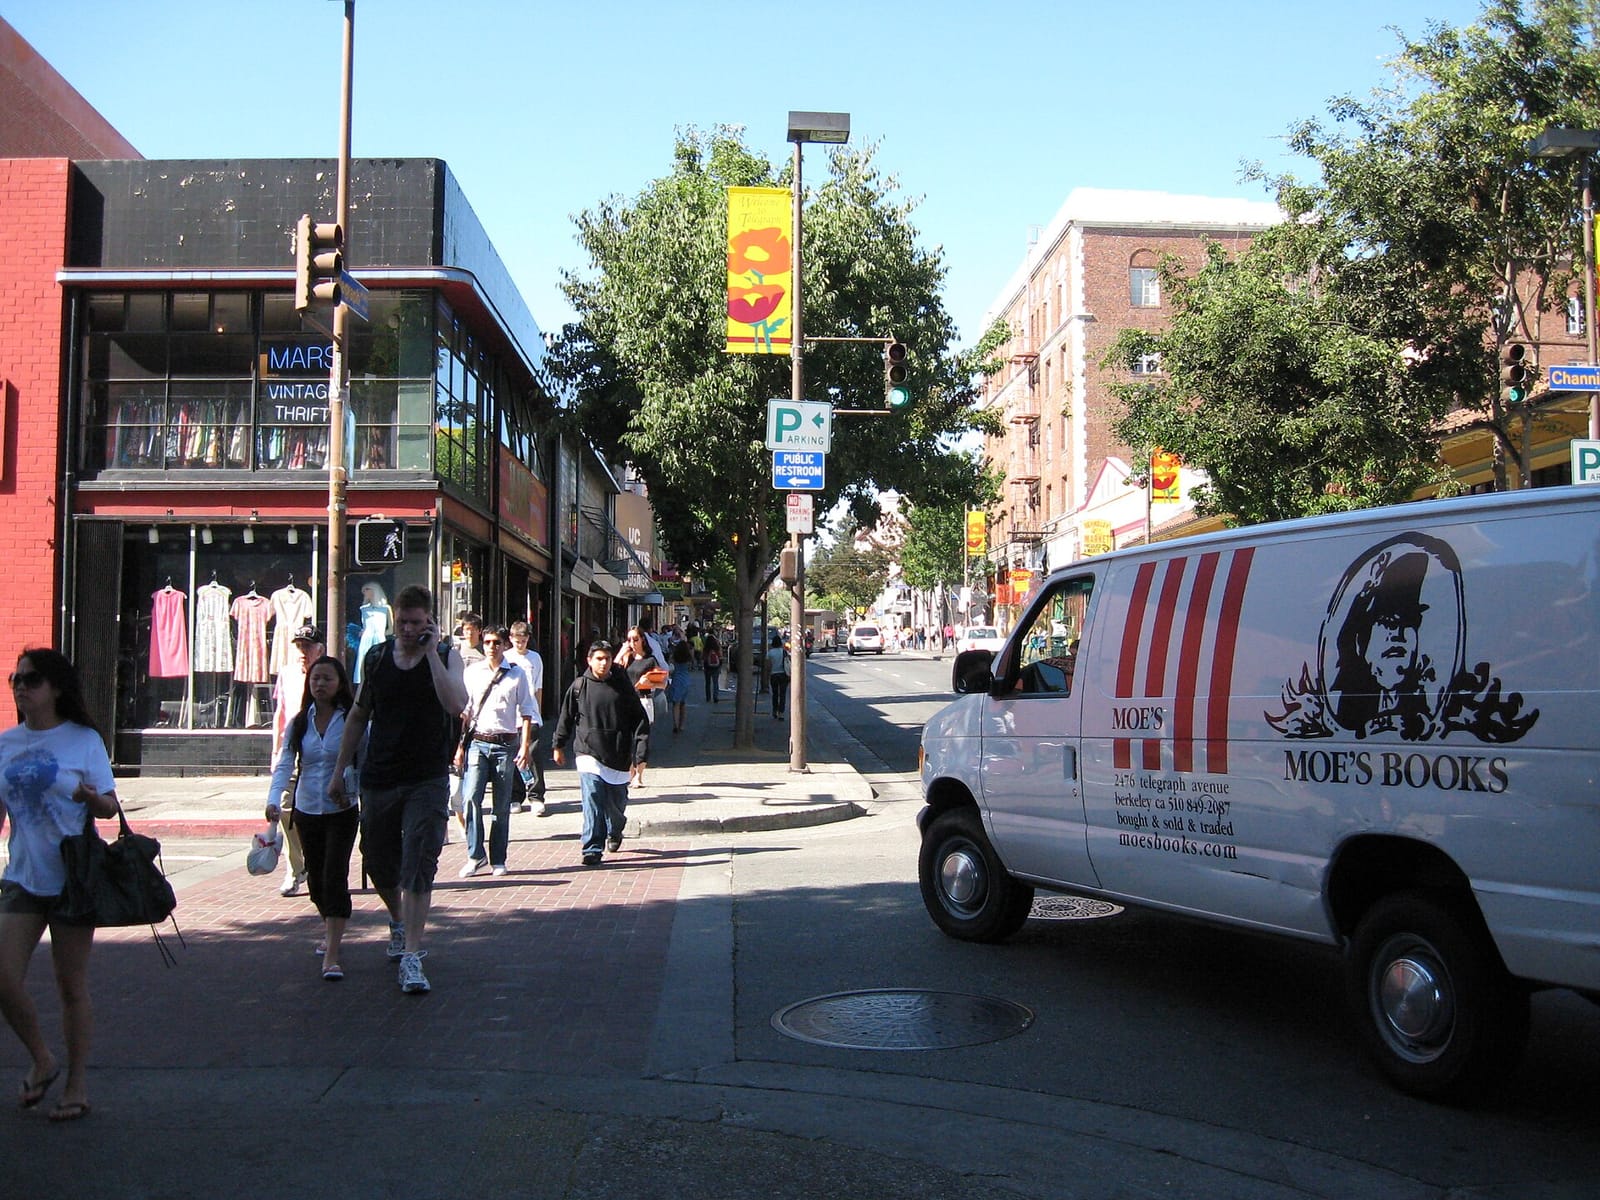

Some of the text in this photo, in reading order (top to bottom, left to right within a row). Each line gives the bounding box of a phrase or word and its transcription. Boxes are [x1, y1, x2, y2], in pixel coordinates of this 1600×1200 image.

[270, 346, 334, 369] MARS
[268, 384, 330, 400] VINTAG
[274, 405, 330, 422] THRIFT
[783, 454, 815, 465] PUBLIC
[776, 466, 821, 477] RESTROOM
[788, 496, 798, 506] NO
[789, 507, 810, 516] PARKING
[628, 527, 641, 546] UC
[1112, 705, 1164, 731] MOE'S
[1284, 750, 1509, 794] MOE'S BOOKS
[1114, 773, 1230, 795] 2476 telegraph avenue
[1114, 792, 1152, 812] berkeley
[1155, 797, 1166, 810] ca
[1168, 796, 1185, 812] 510
[1116, 811, 1235, 837] bought & sold & traded
[1119, 832, 1238, 860] moesbooks.com
